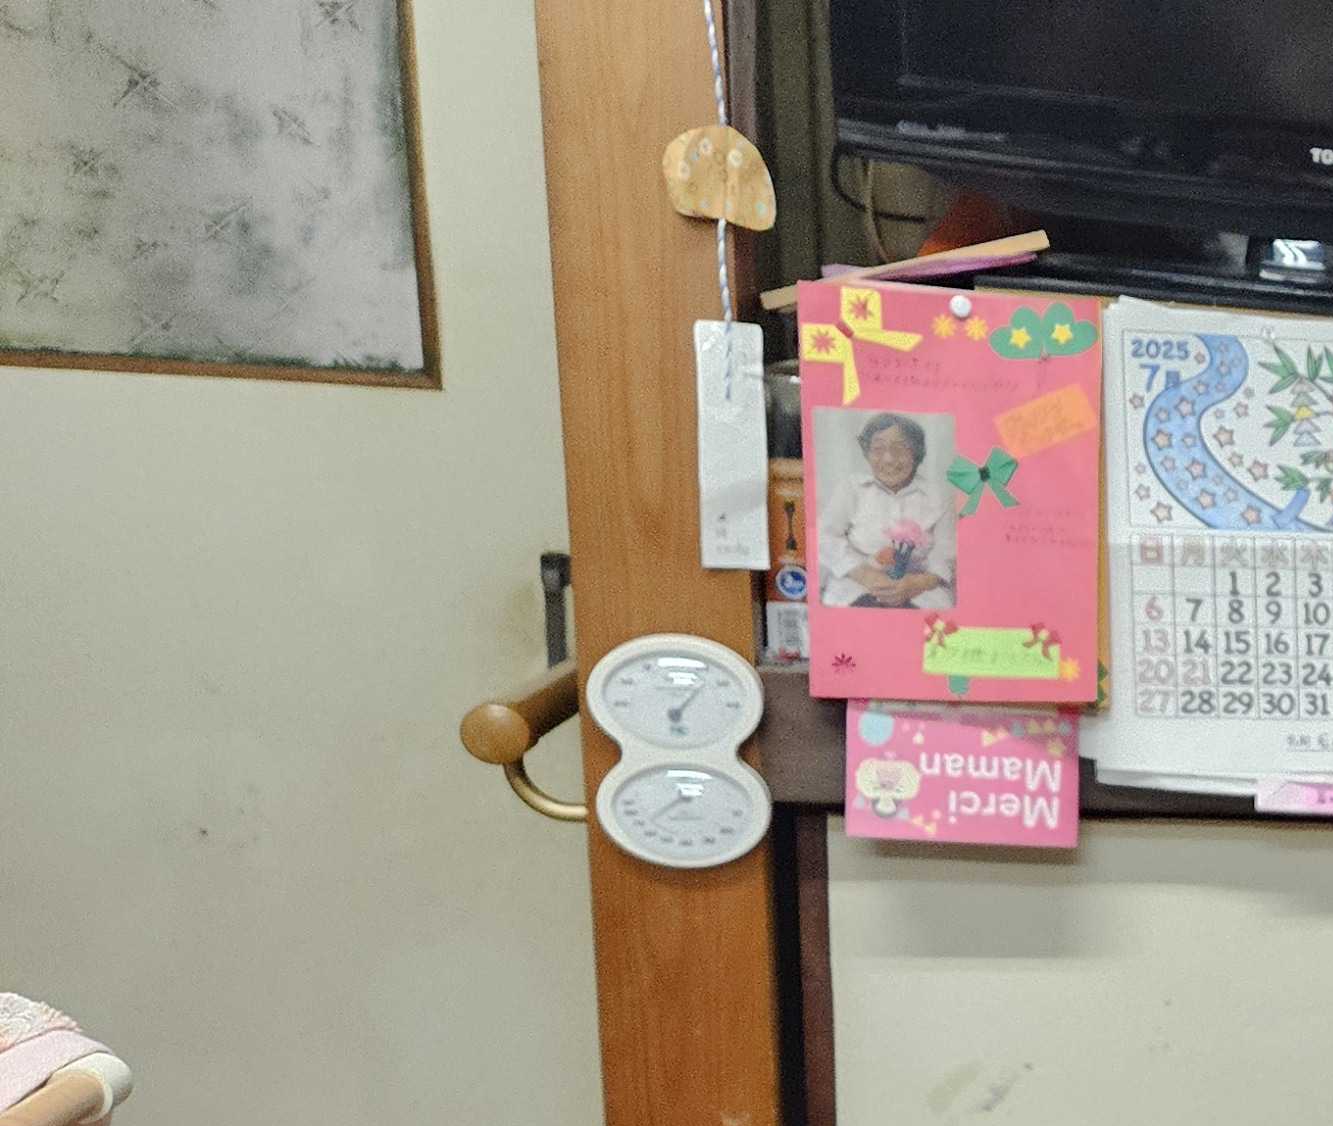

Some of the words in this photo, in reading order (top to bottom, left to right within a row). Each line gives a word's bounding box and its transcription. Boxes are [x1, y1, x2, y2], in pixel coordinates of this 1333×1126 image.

[1130, 339, 1190, 361] 2025
[1230, 572, 1240, 596] 1
[1266, 572, 1281, 597] 2
[1309, 573, 1323, 596] 3
[1145, 596, 1162, 620] 6
[1186, 599, 1203, 622] 7
[1228, 600, 1244, 623] 8
[1266, 601, 1281, 624] 9
[1304, 602, 1329, 625] 10
[1142, 629, 1168, 652] 13
[1184, 631, 1211, 654] 14
[1225, 632, 1250, 655] 15
[1266, 633, 1289, 655] 16
[1306, 634, 1329, 656] 17
[1138, 661, 1174, 684] 20
[1182, 661, 1211, 685] 21
[1221, 662, 1253, 685] 22
[1263, 663, 1292, 686] 23
[1302, 663, 1331, 686] 24
[1138, 692, 1168, 713] 27
[1181, 691, 1213, 715] 28
[1223, 692, 1253, 715] 29
[1263, 693, 1294, 716] 30
[1305, 693, 1329, 715] 31
[919, 751, 1062, 792] Maman
[949, 790, 1059, 828] Merci
